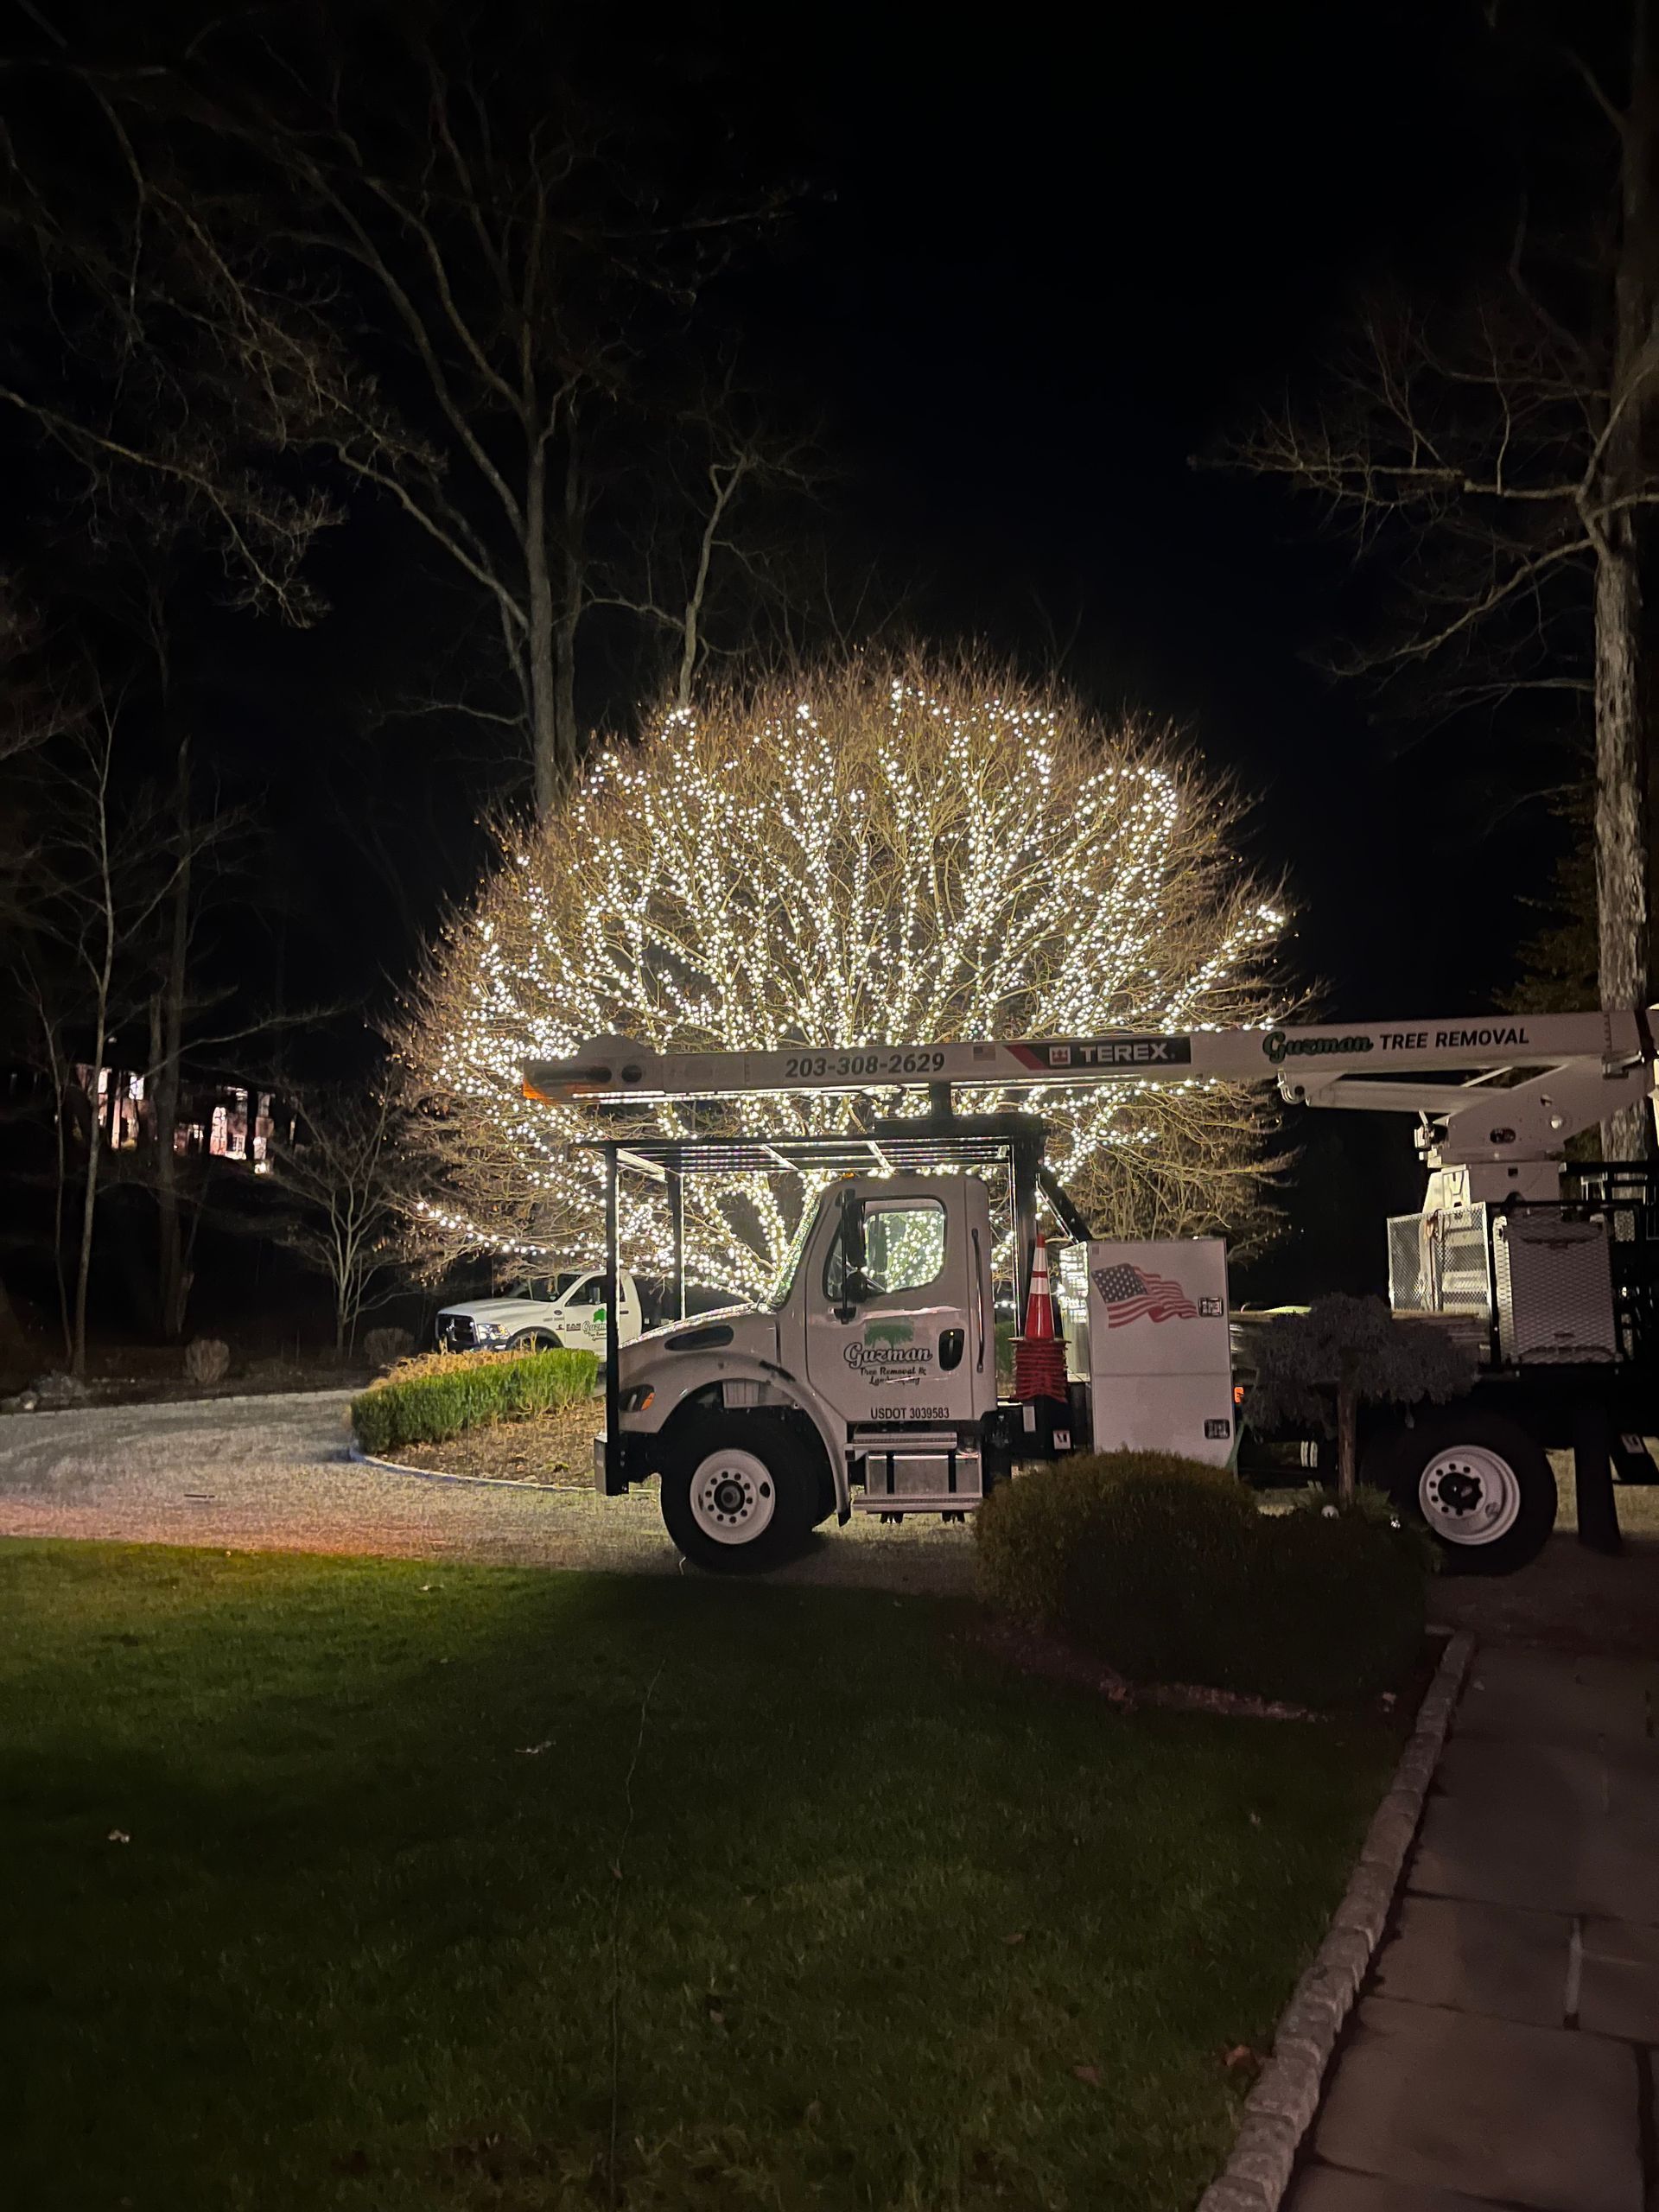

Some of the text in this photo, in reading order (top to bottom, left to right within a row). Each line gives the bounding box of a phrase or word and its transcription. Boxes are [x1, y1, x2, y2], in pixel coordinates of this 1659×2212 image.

[1080, 1043, 1168, 1063] TEREX
[1262, 1028, 1529, 1064] Guzman TREE REMOVAL
[785, 1052, 945, 1078] 203-308-2629
[843, 1342, 933, 1369] Guzman
[880, 1367, 916, 1376] Removal
[870, 1408, 950, 1420] USDOT 3039583
